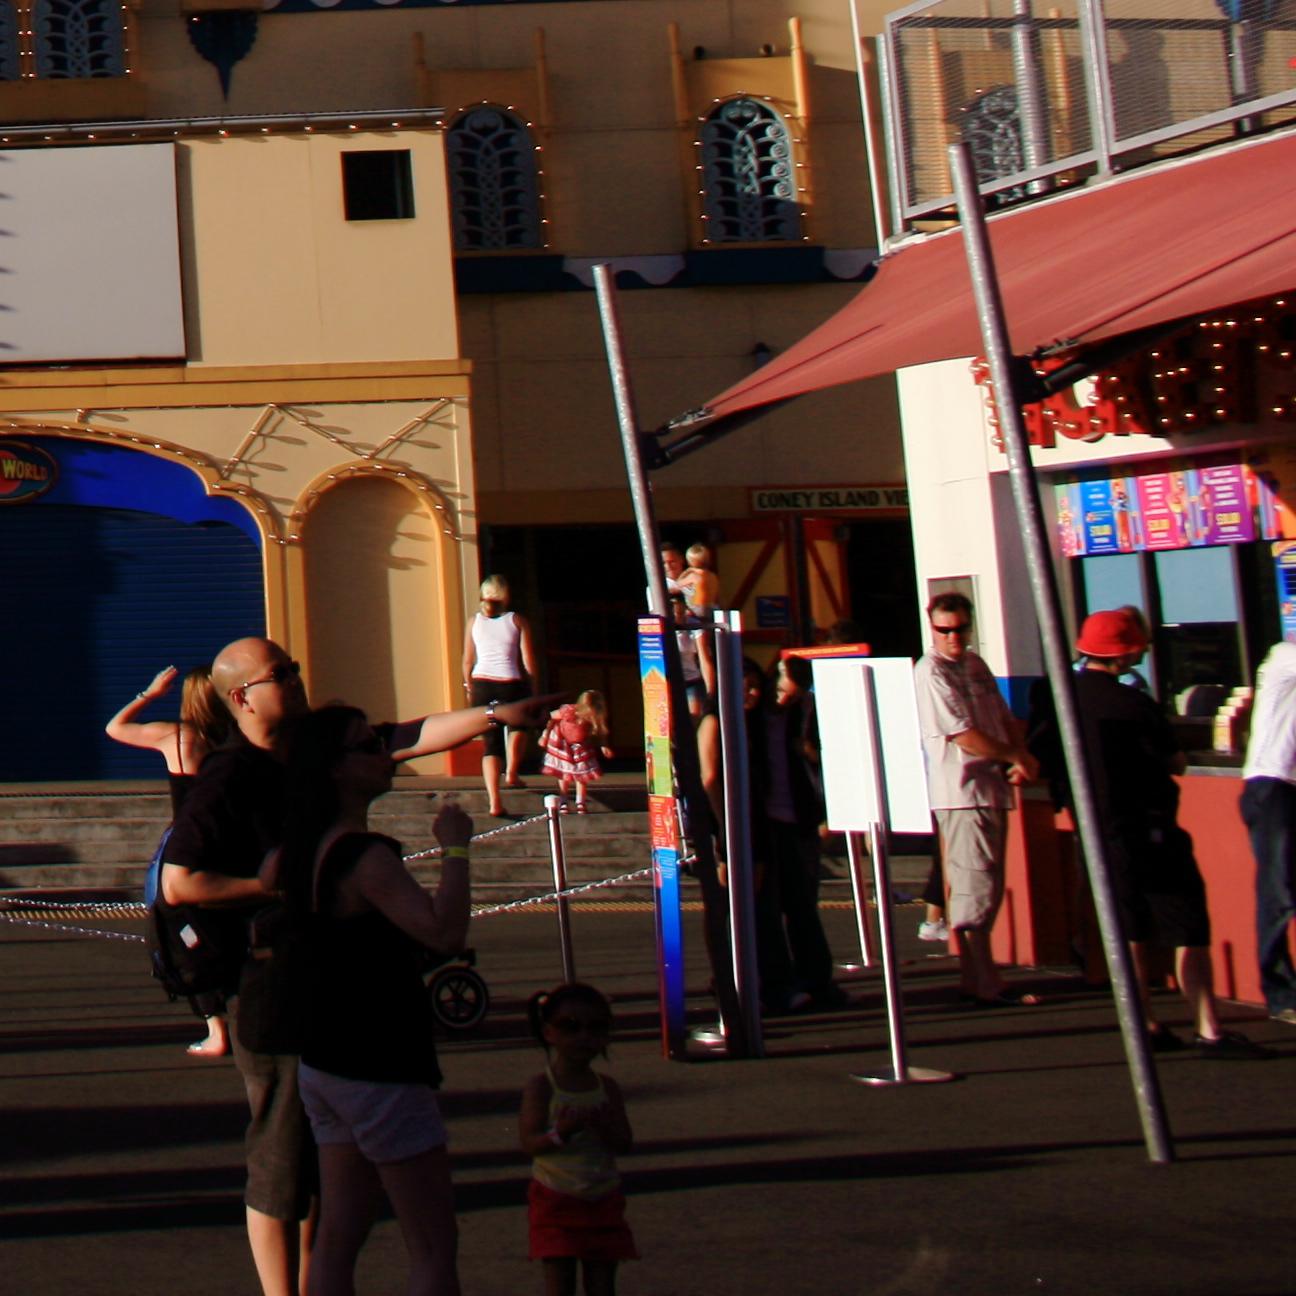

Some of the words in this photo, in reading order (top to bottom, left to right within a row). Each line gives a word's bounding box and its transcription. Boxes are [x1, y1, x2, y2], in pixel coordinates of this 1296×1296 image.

[2, 459, 48, 481] WORLD
[758, 491, 815, 509] CONEY
[819, 489, 879, 507] ISLAND
